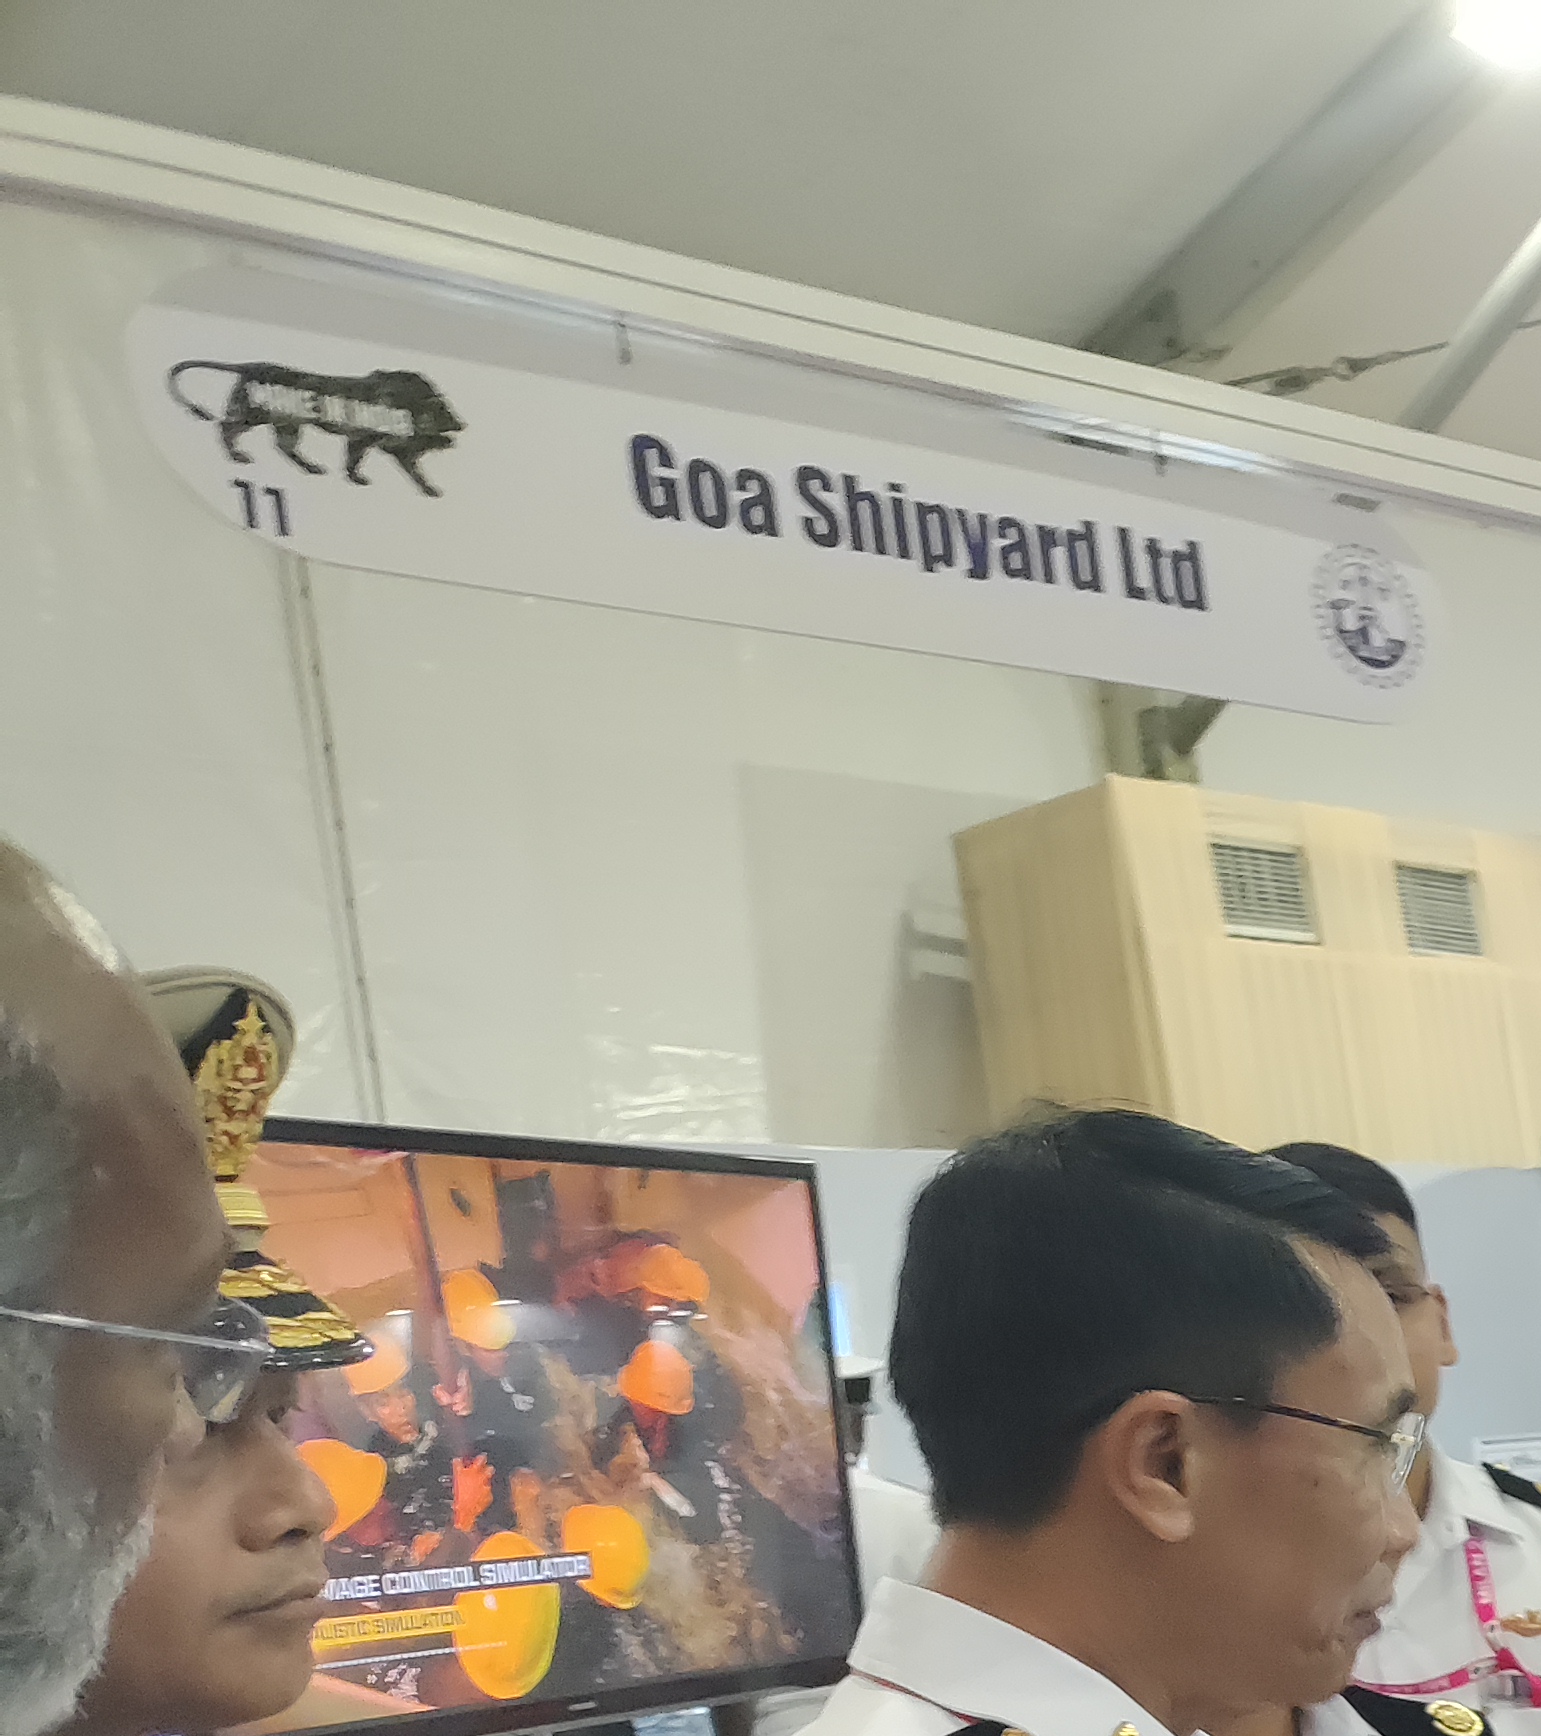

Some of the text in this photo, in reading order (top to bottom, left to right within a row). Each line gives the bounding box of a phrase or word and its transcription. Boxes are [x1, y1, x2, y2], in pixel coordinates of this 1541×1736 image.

[231, 478, 290, 536] 11
[629, 431, 1211, 612] Goa Shipyard Ltd
[382, 1566, 479, 1595] CONTROL
[481, 1554, 591, 1586] SIMULATOR
